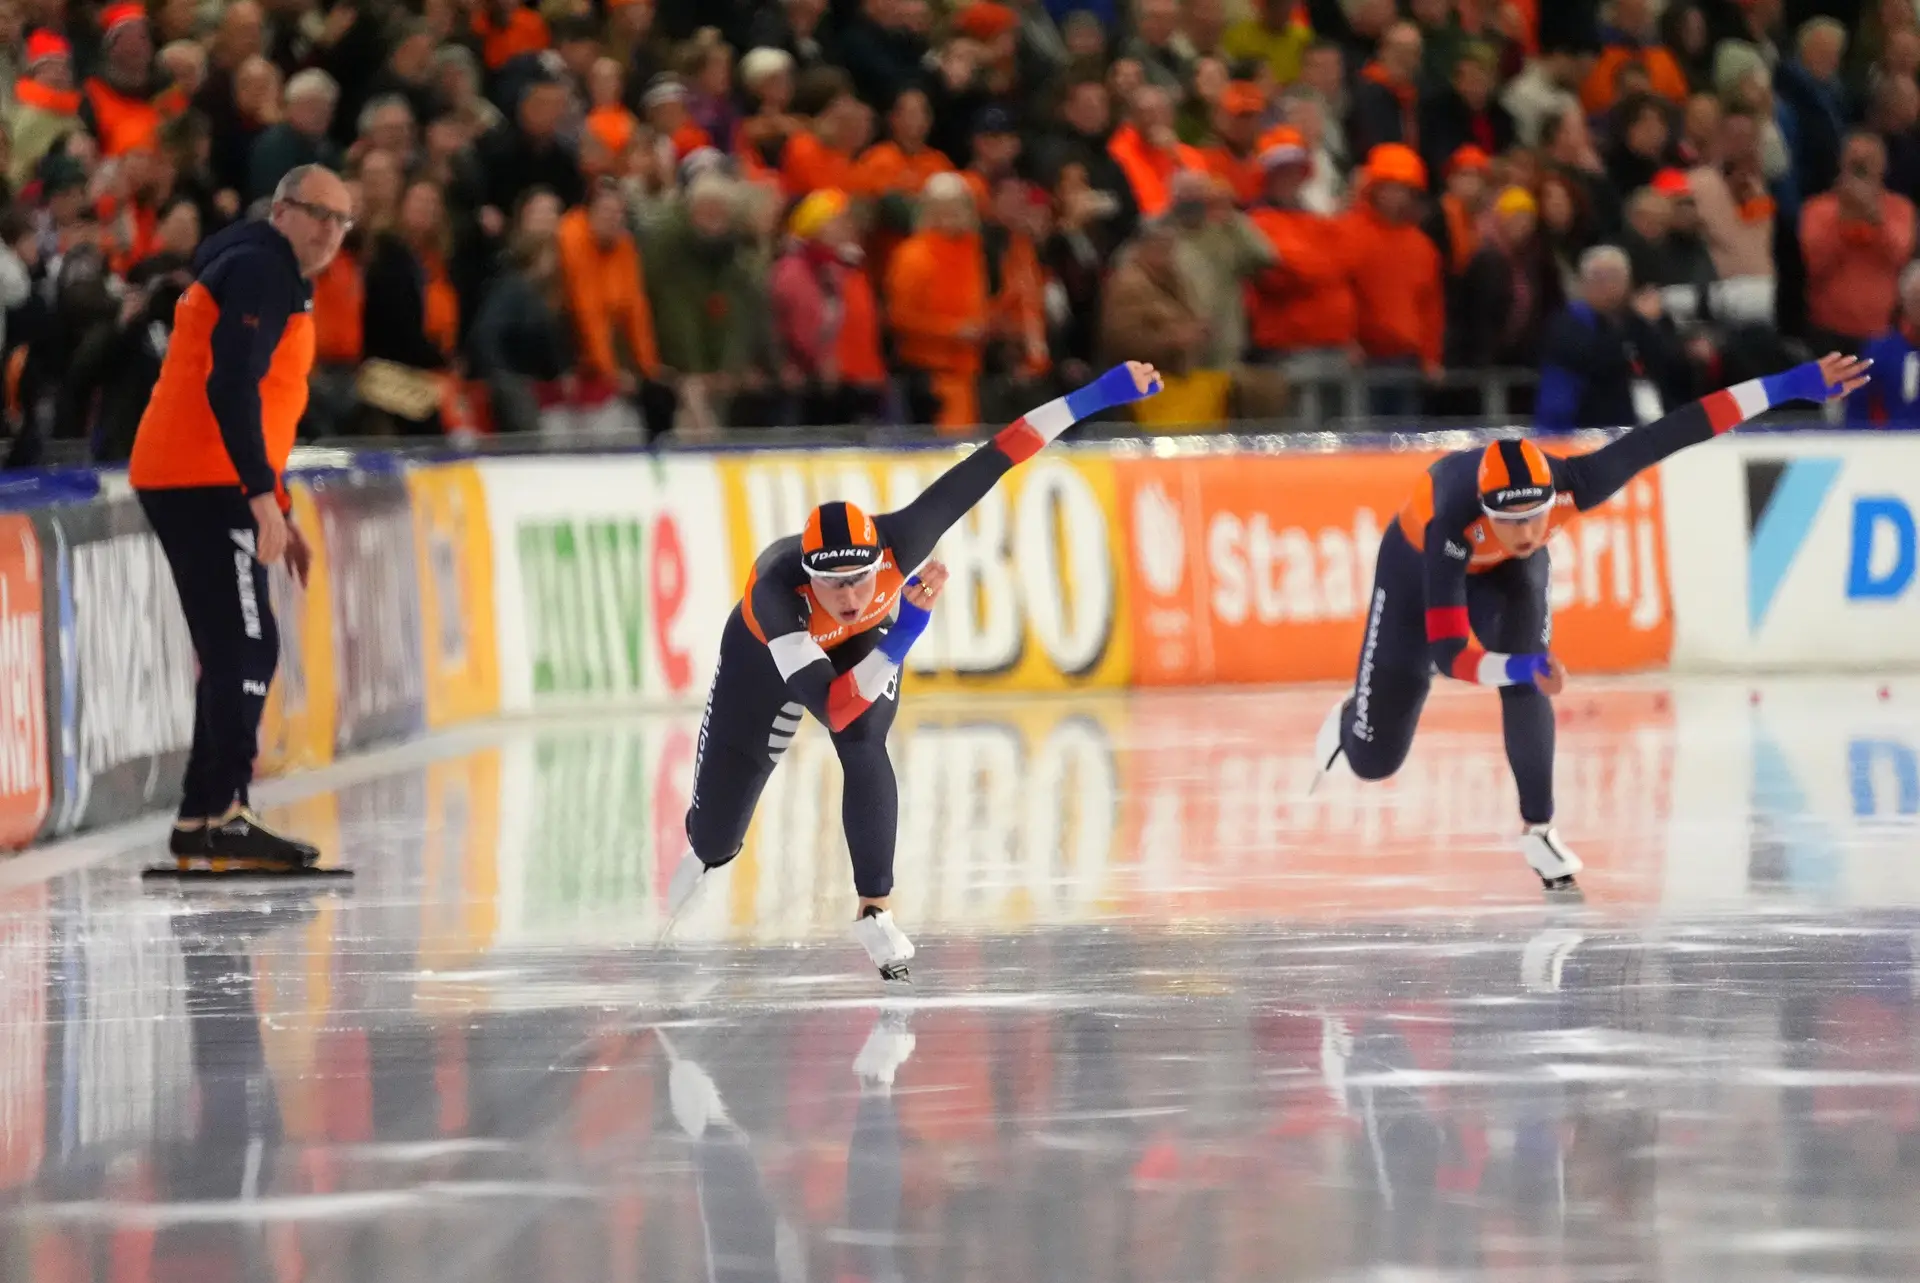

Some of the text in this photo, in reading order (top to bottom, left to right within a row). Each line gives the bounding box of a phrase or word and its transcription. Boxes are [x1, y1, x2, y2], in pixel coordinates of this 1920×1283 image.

[1505, 486, 1543, 500] DAIKIN
[819, 547, 871, 561] DAIKIN
[1208, 478, 1664, 632] staaterij
